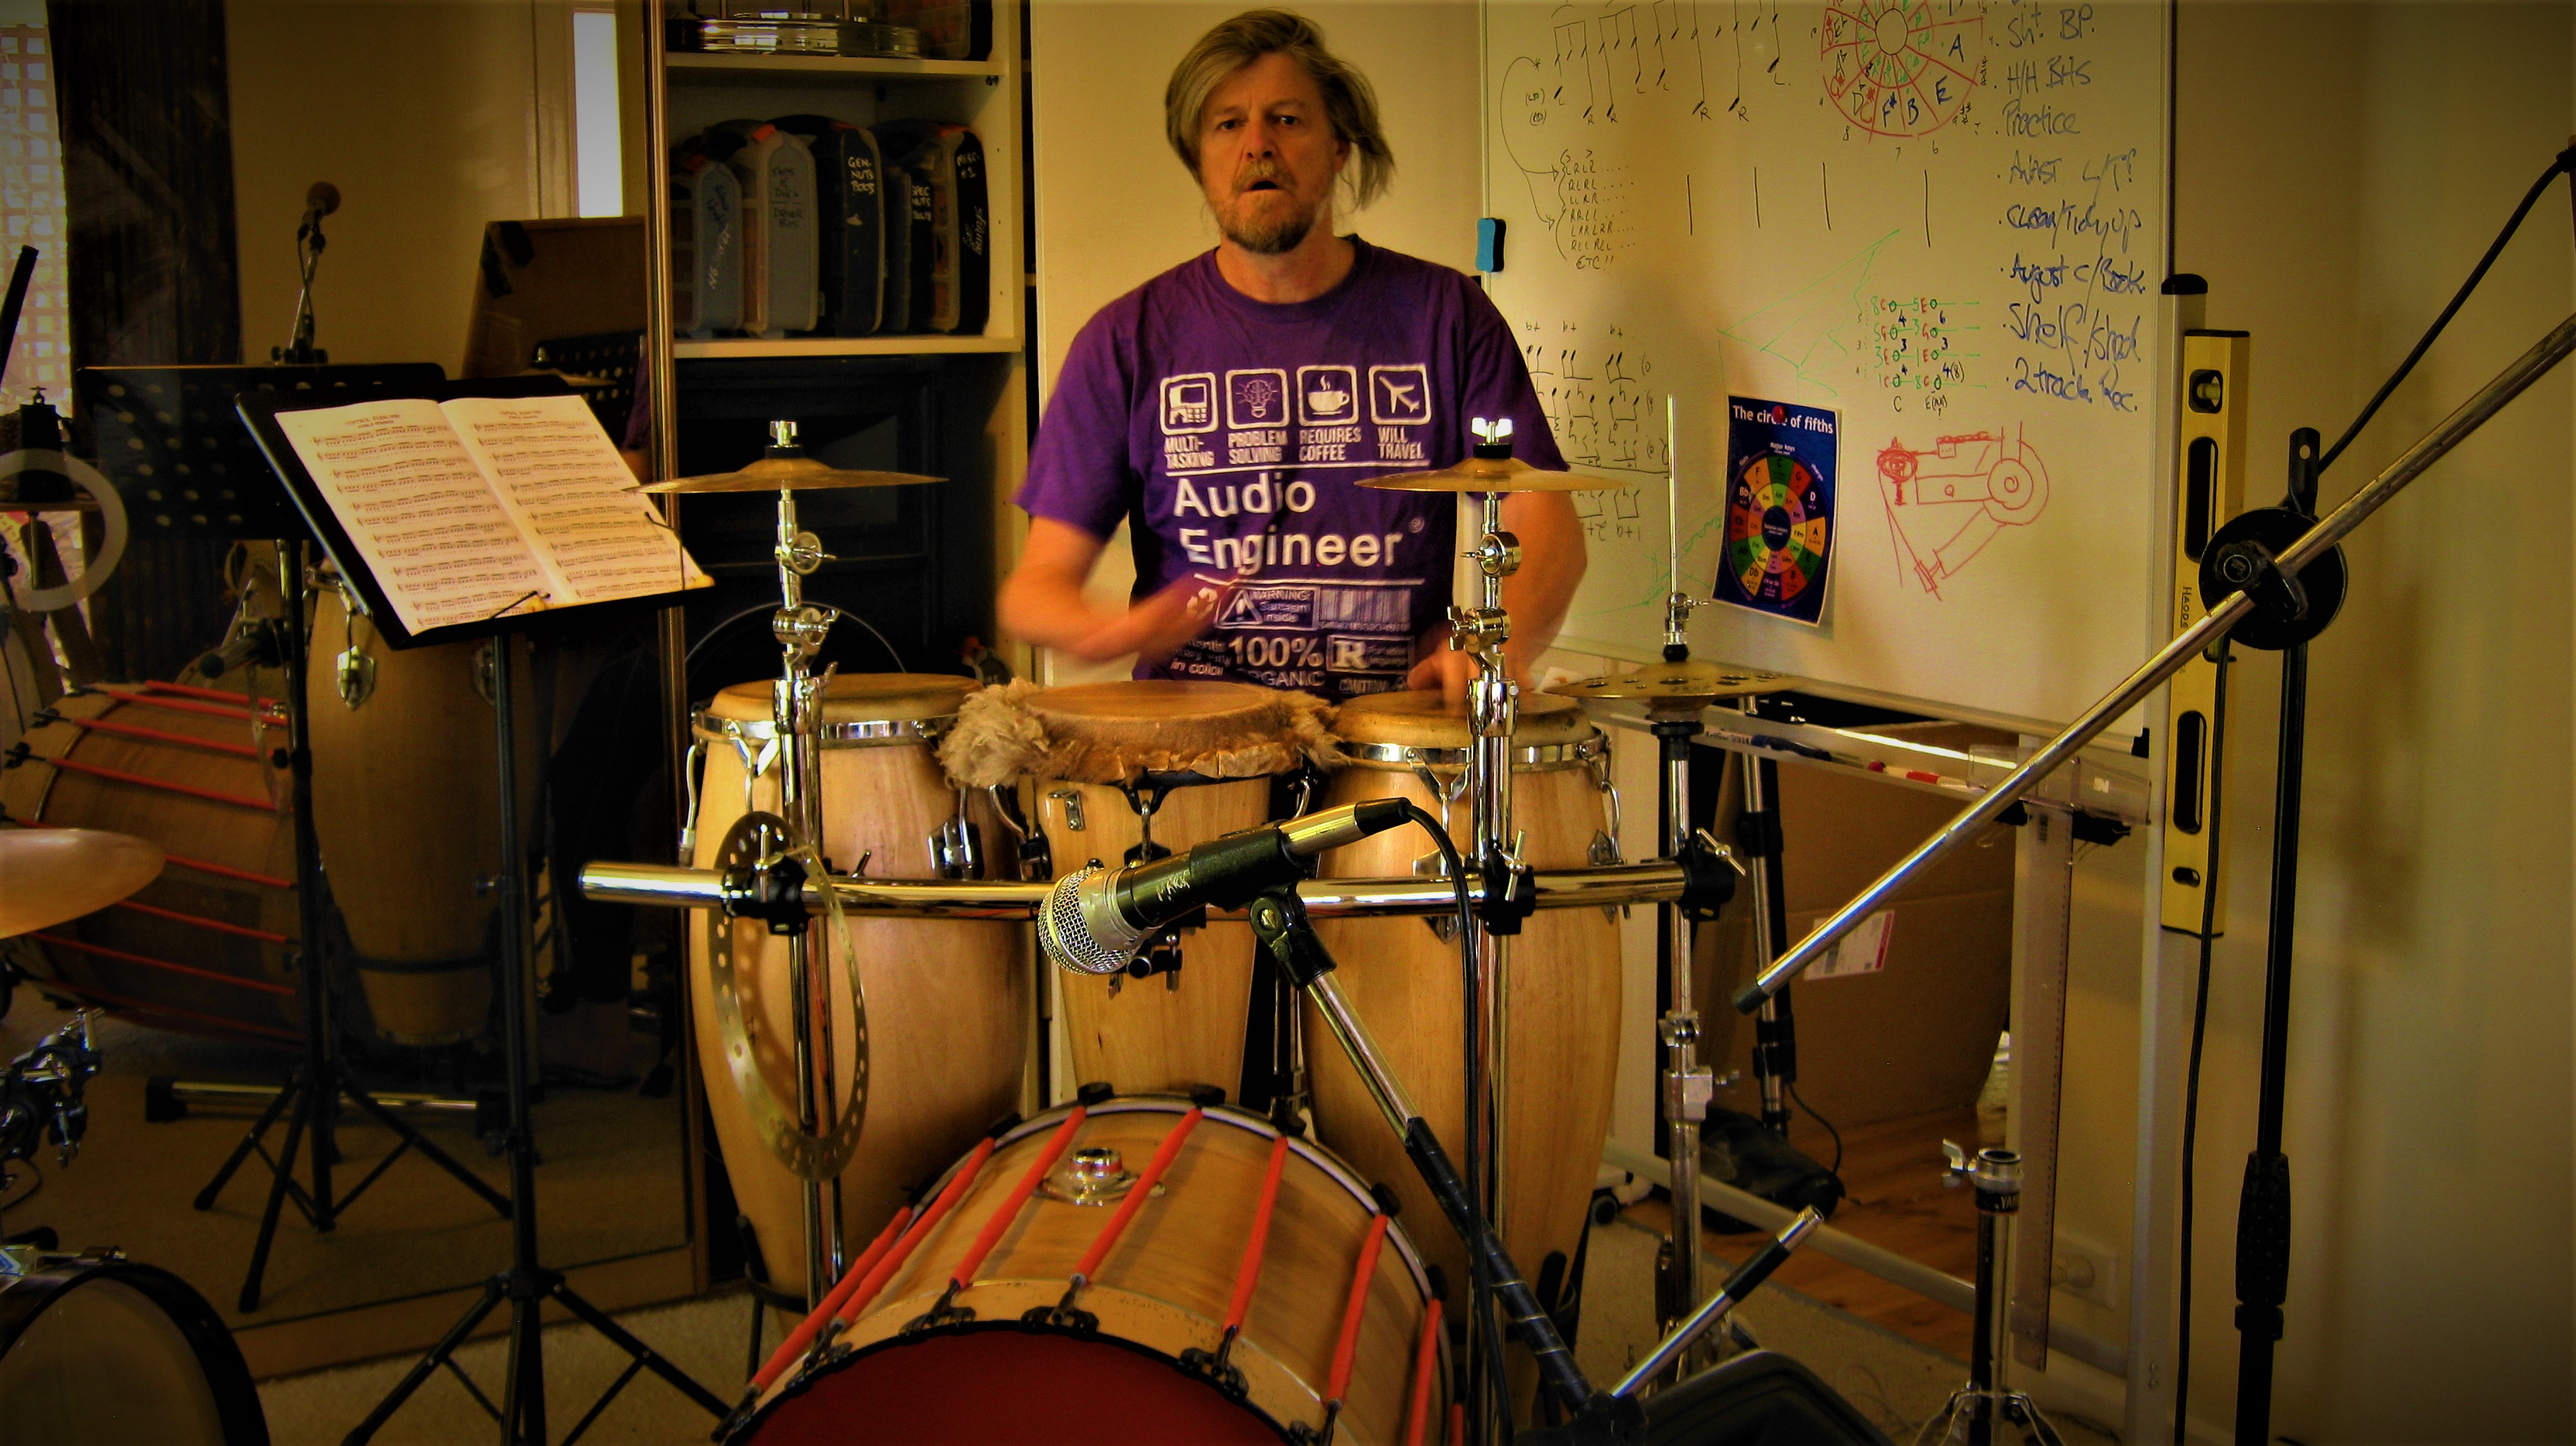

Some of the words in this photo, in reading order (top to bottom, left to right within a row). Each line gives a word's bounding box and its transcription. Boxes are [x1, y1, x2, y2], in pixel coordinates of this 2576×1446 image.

[1732, 405, 1755, 422] The
[1790, 414, 1803, 429] of
[1803, 415, 1834, 434] fifths
[1227, 430, 1289, 448] PROBLEM
[1299, 426, 1362, 444] REQUIRES
[1377, 426, 1409, 443] WILL
[1164, 450, 1216, 470] TASKING
[1228, 446, 1283, 465] SOLVING
[1298, 443, 1347, 462] COFFEE
[1378, 442, 1425, 460] TRAVEL
[1173, 472, 1316, 518] Audio
[1810, 491, 1816, 501] D
[1812, 527, 1818, 537] A
[1179, 525, 1404, 576] Engineer
[1228, 635, 1325, 667] 100%
[1332, 640, 1368, 669] R
